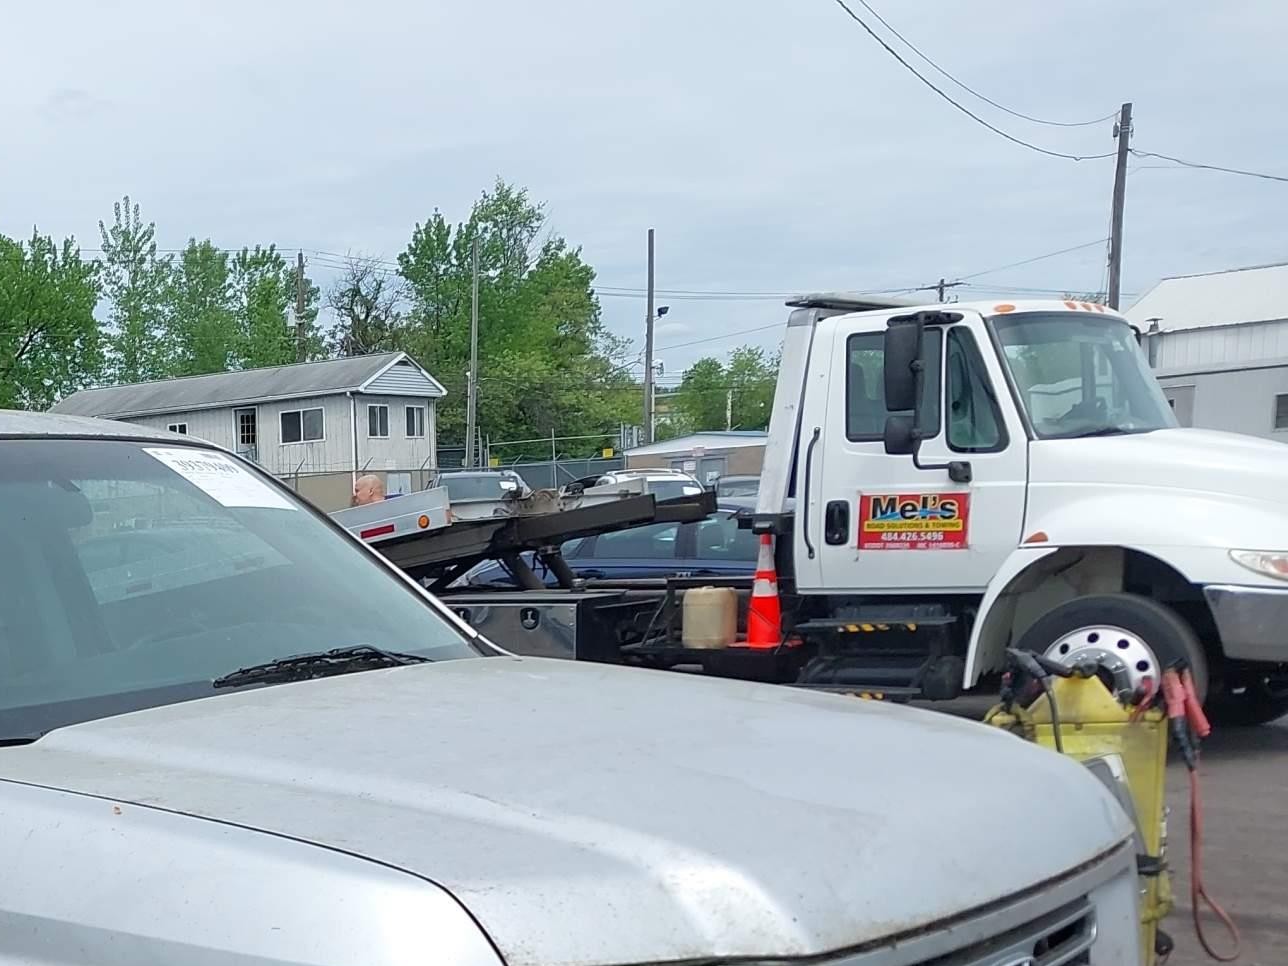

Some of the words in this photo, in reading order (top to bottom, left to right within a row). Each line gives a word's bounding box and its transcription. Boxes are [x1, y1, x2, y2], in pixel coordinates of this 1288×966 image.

[870, 495, 958, 520] Mel's
[887, 522, 923, 530] SOLUTIONS
[931, 521, 961, 529] TOWING
[880, 532, 944, 542] 484.426.5496
